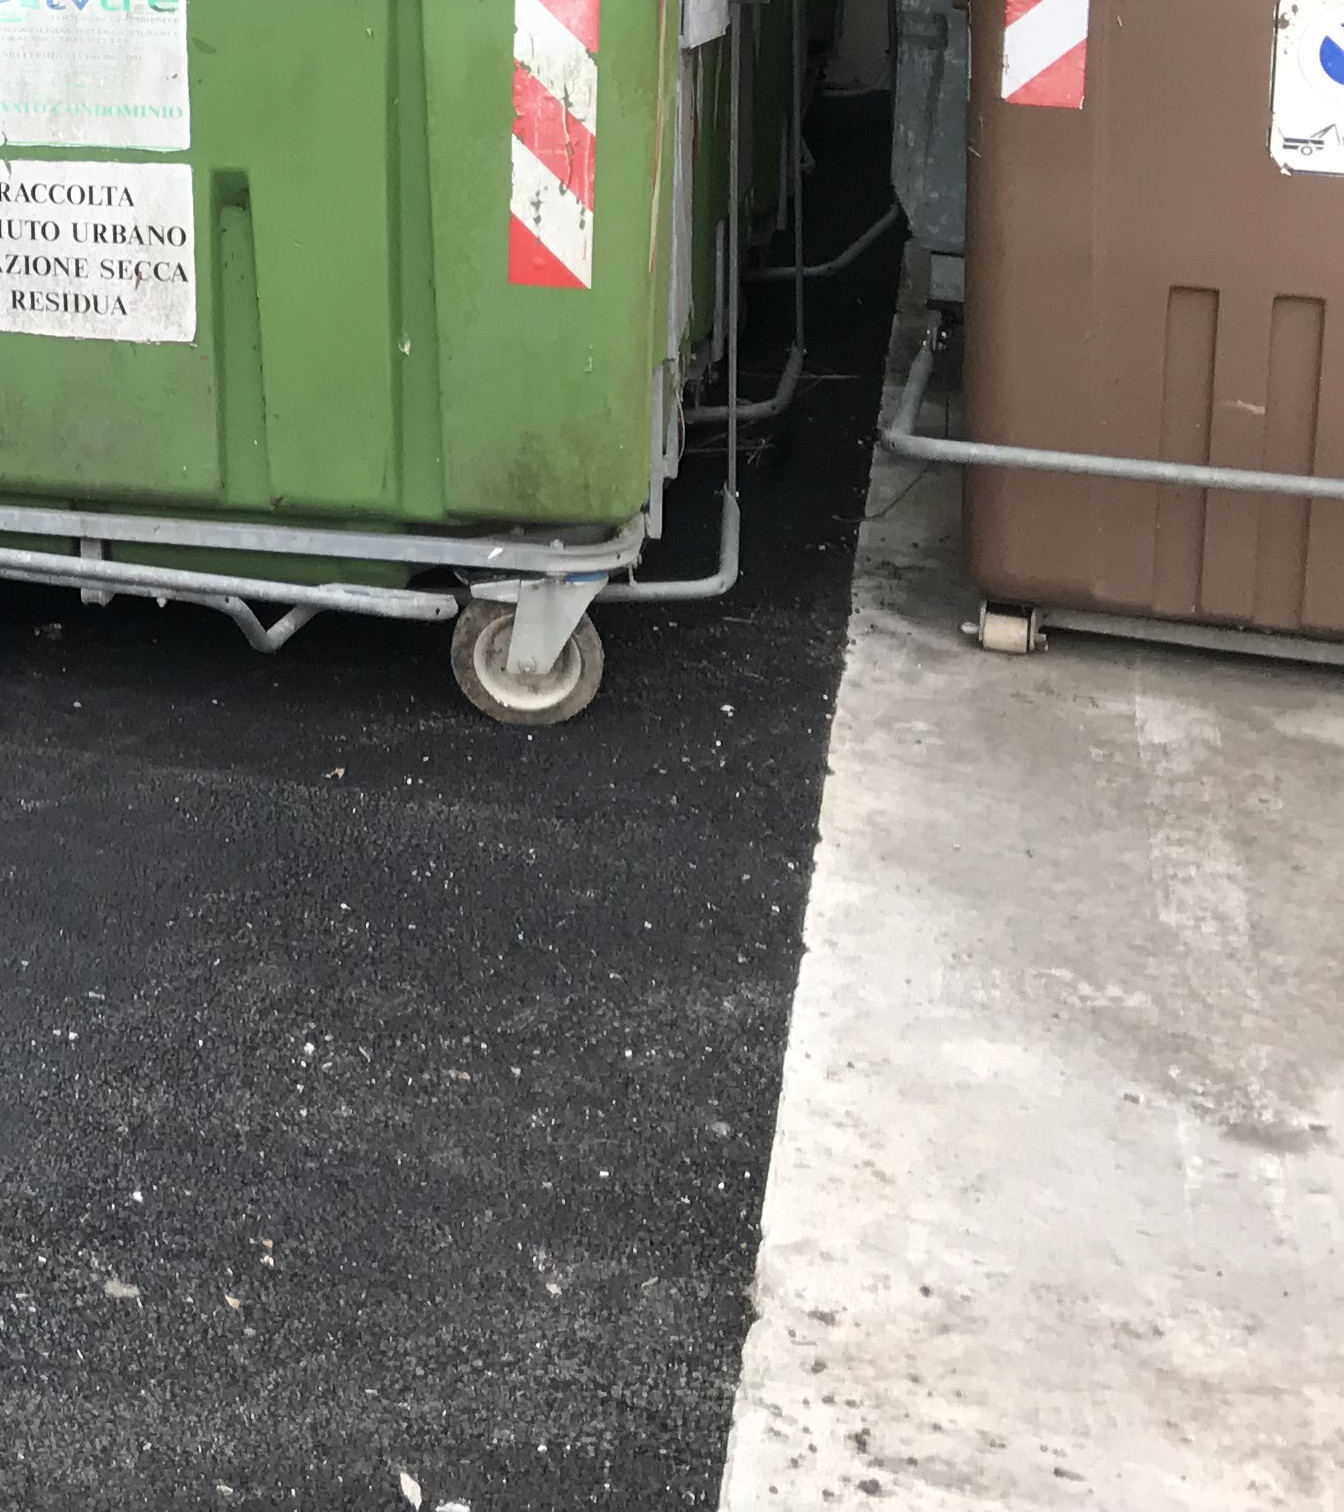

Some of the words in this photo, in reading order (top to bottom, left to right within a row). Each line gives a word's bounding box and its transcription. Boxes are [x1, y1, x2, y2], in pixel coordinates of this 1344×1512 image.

[53, 101, 182, 119] CONDOMINIO
[72, 223, 187, 246] URBANO
[100, 260, 188, 282] SECCA
[12, 289, 128, 315] RESIDUA
